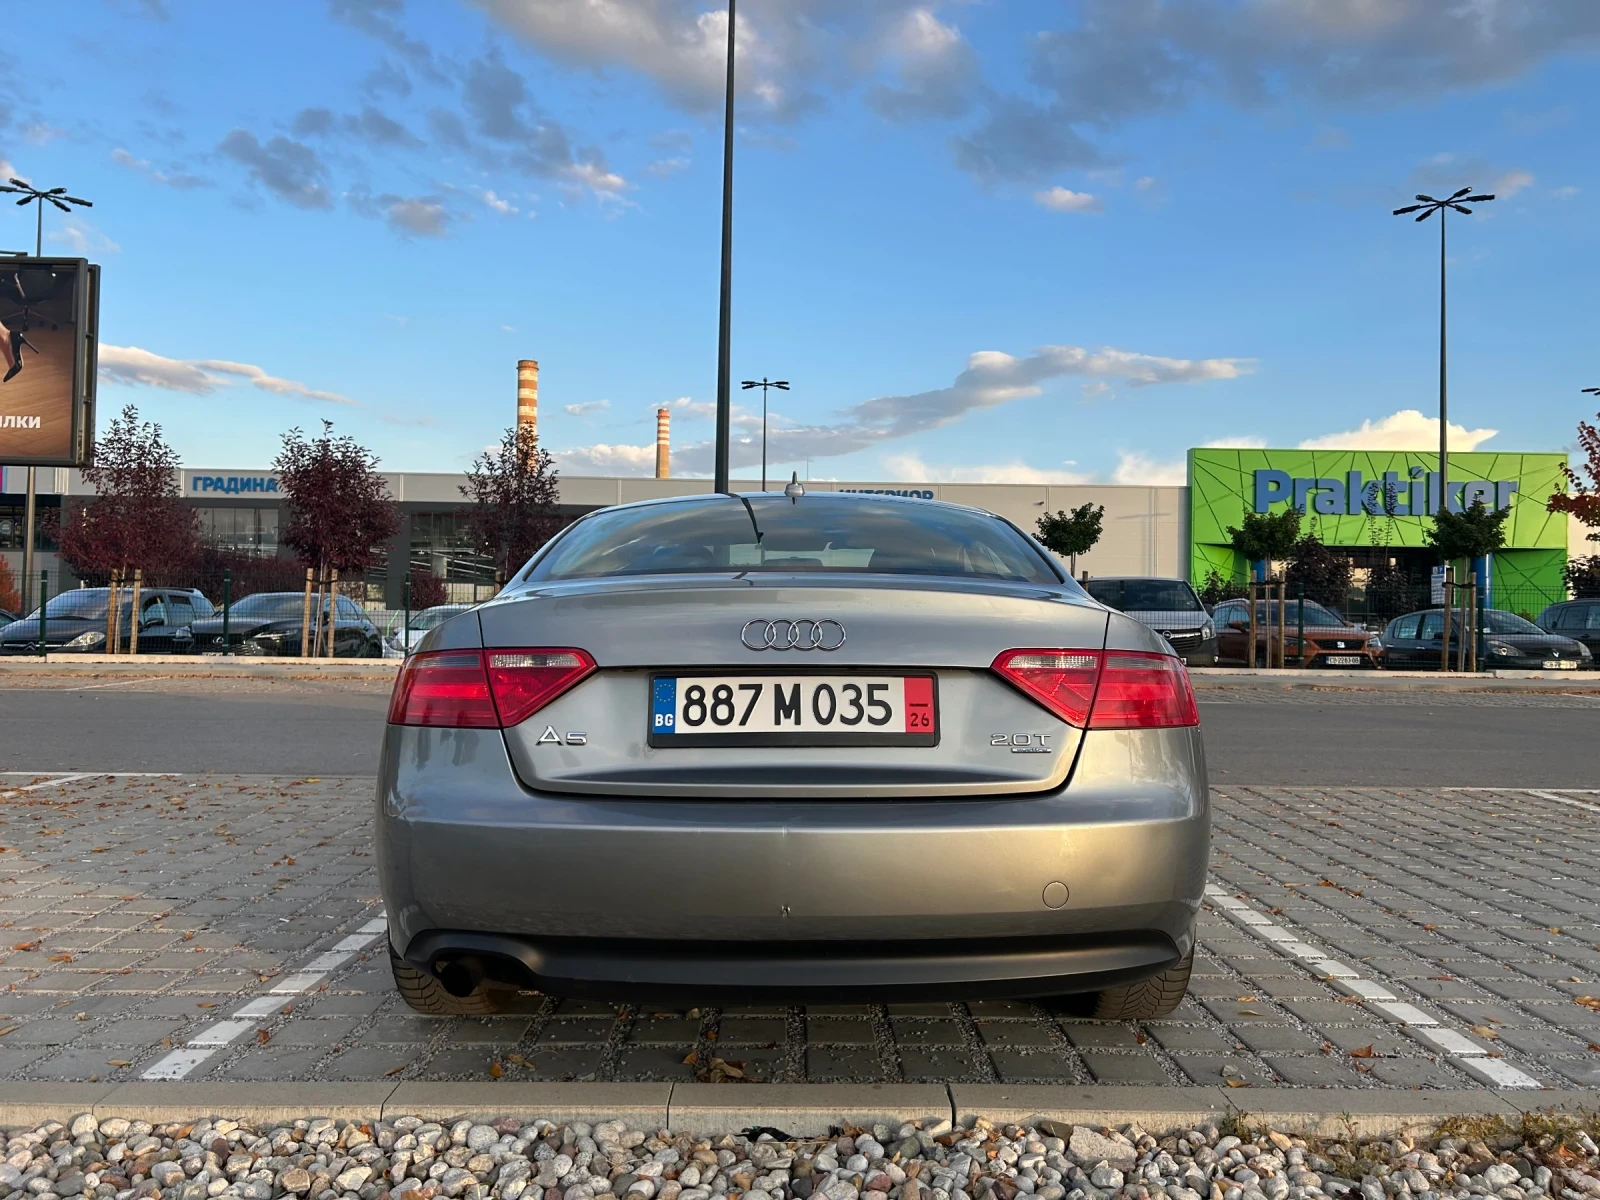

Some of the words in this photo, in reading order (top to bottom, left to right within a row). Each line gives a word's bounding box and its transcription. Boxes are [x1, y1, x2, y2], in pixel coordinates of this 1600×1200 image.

[192, 476, 278, 494] ГРАДИНА
[1254, 465, 1519, 516] Praktiker
[682, 684, 763, 727] 887
[774, 683, 802, 726] M
[812, 683, 893, 726] 035
[655, 713, 674, 727] BG
[909, 712, 930, 727] 26
[535, 725, 587, 746] A5
[990, 733, 1051, 746] 2.0T
